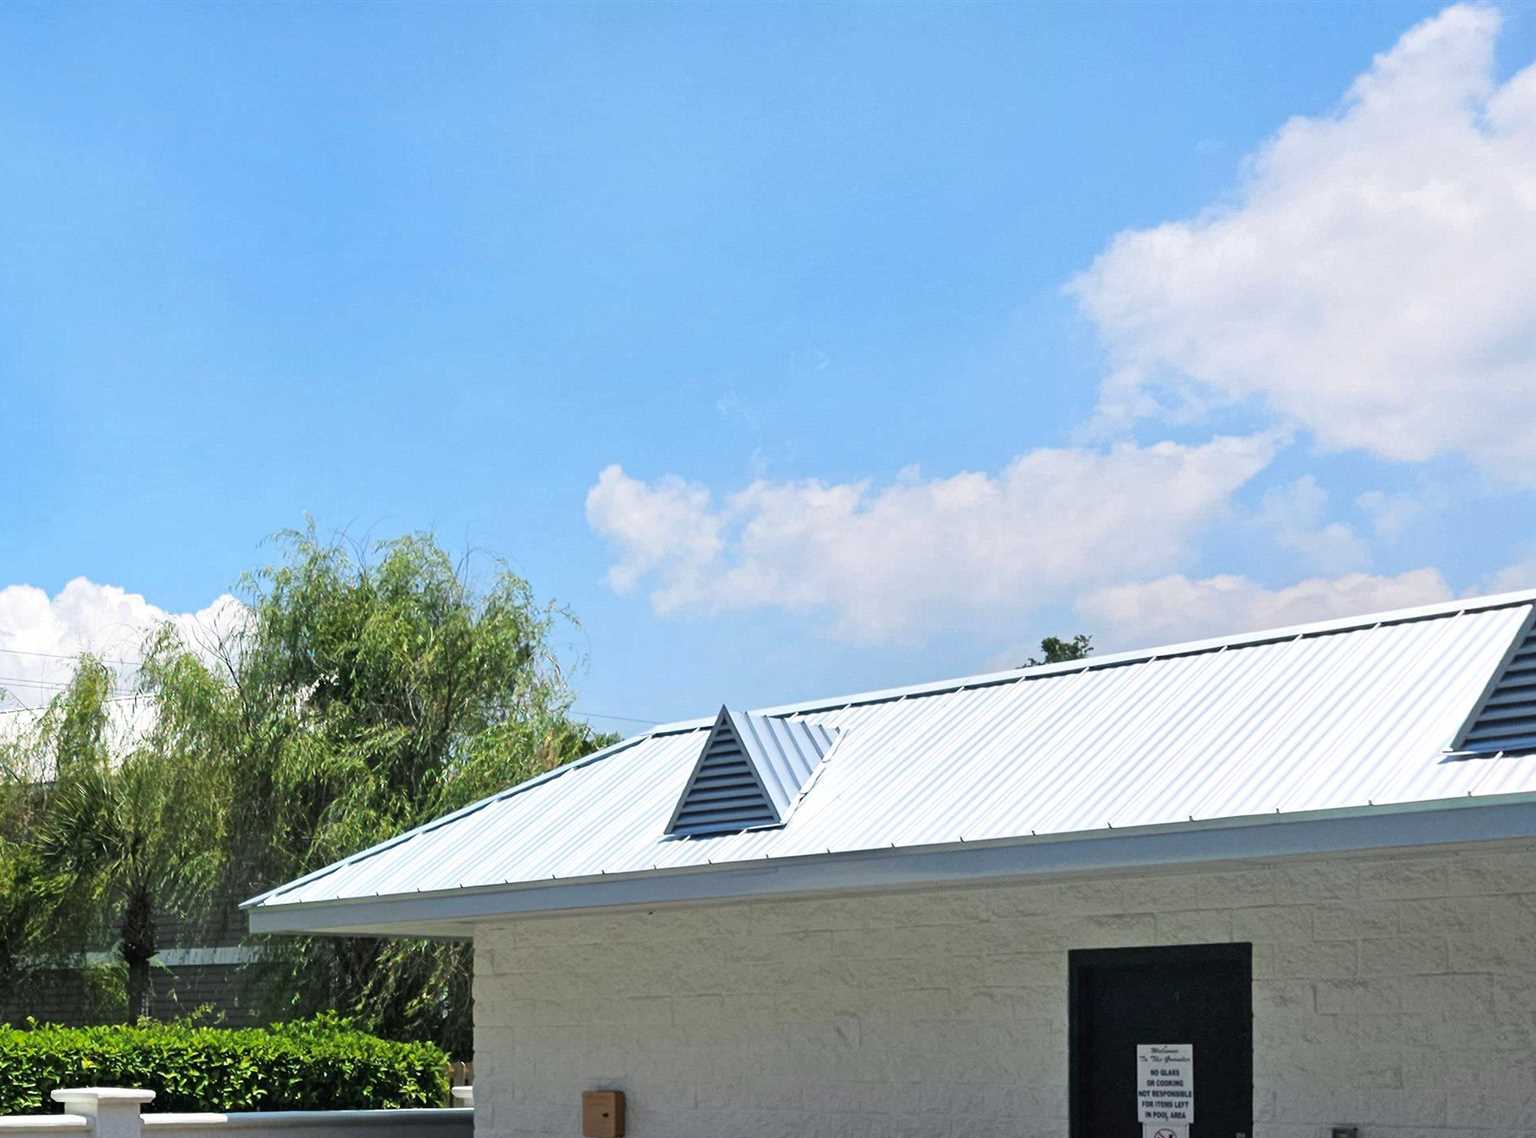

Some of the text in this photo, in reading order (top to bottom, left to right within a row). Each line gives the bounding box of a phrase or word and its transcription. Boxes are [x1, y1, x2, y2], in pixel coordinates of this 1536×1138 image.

[1150, 1069, 1180, 1077] NO GLASS
[1146, 1079, 1184, 1087] OR COOKING
[1138, 1090, 1192, 1098] NOT RESPONSIBLE
[1142, 1100, 1154, 1108] FOR
[1175, 1101, 1189, 1109] LEFT
[1145, 1111, 1152, 1119] IN
[1170, 1111, 1186, 1119] AREA
